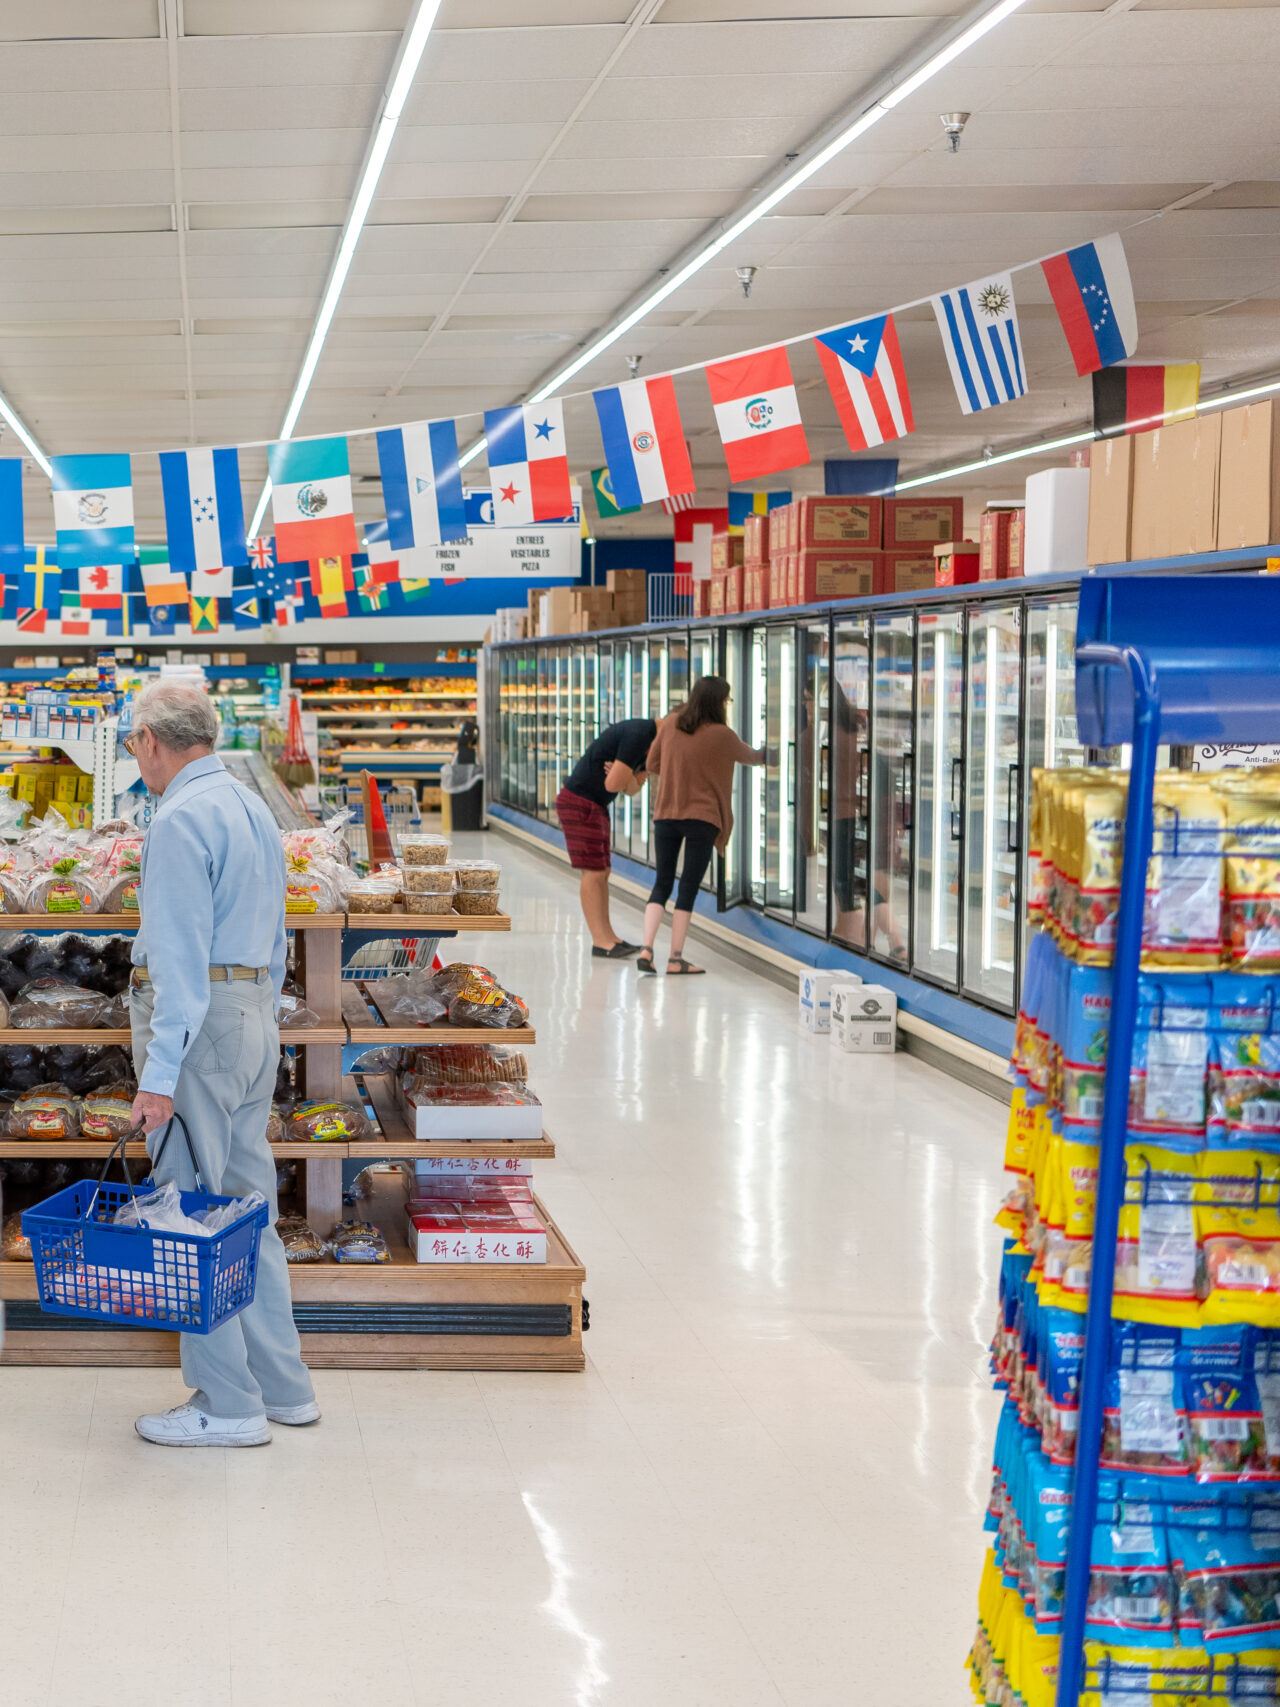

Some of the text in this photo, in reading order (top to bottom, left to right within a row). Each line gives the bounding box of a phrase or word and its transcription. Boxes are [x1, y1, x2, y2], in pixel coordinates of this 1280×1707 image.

[516, 535, 545, 545] ENTREES
[436, 550, 460, 559] FROZEN
[511, 549, 550, 558] VEGETABLES
[441, 562, 456, 572] FISH
[521, 562, 540, 572] PIZZA
[143, 796, 155, 824] core
